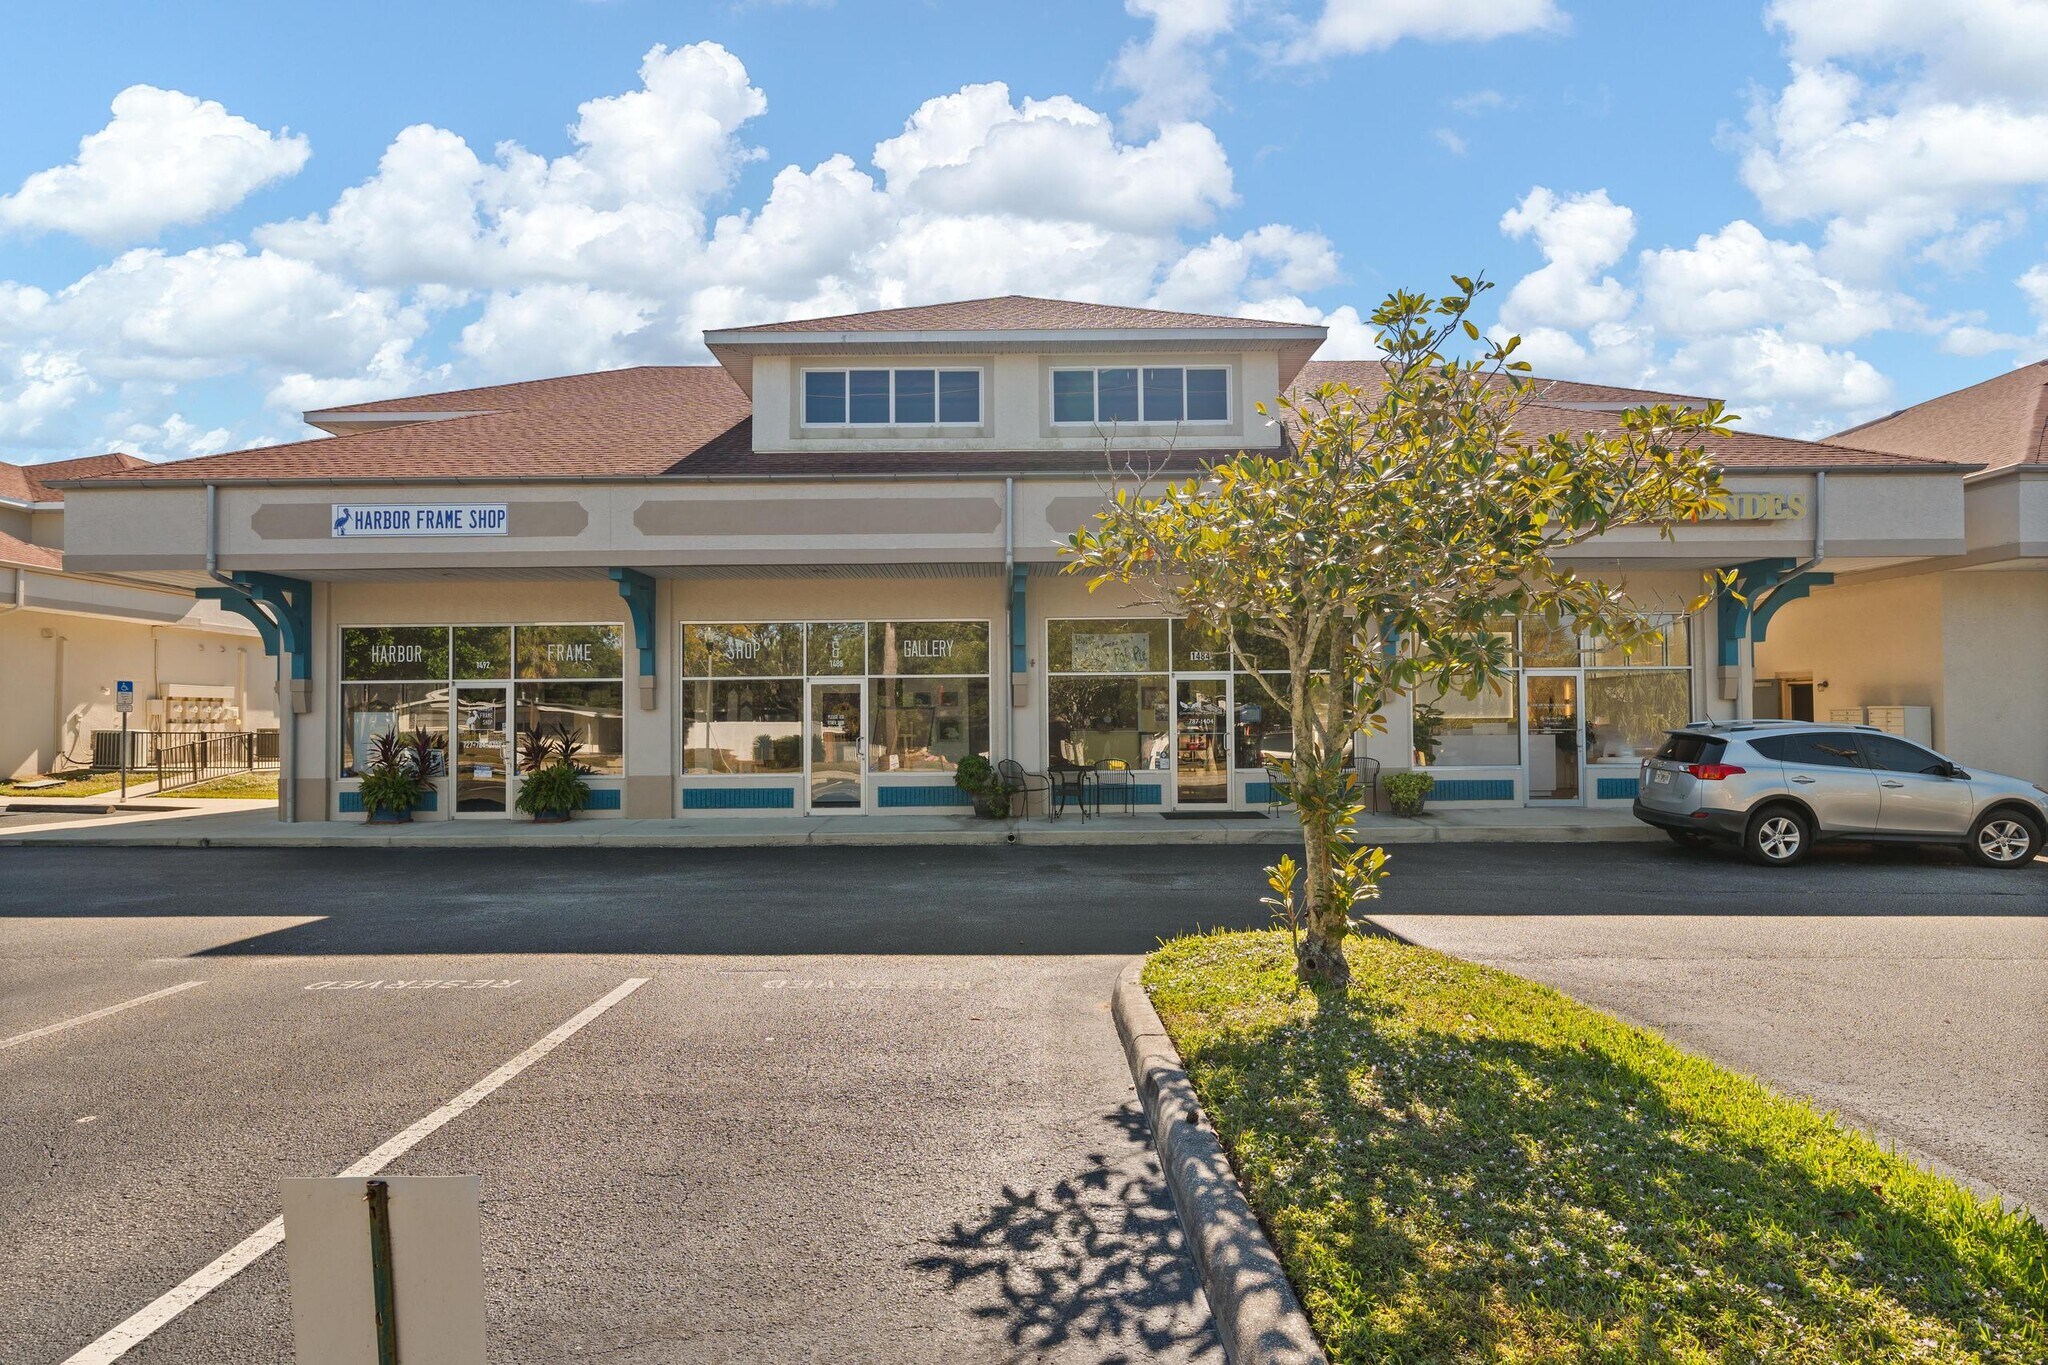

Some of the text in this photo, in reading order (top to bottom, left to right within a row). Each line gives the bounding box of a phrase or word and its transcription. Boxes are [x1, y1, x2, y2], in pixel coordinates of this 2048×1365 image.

[355, 509, 506, 529] HARBOR FRAME SHOP
[371, 645, 422, 663] HARBOR
[547, 643, 592, 661] FRAME
[726, 642, 761, 660] SHOP
[904, 640, 954, 658] GALLERY
[1190, 651, 1210, 660] 1484
[475, 661, 490, 669] 1492
[304, 979, 523, 990] RESERVED
